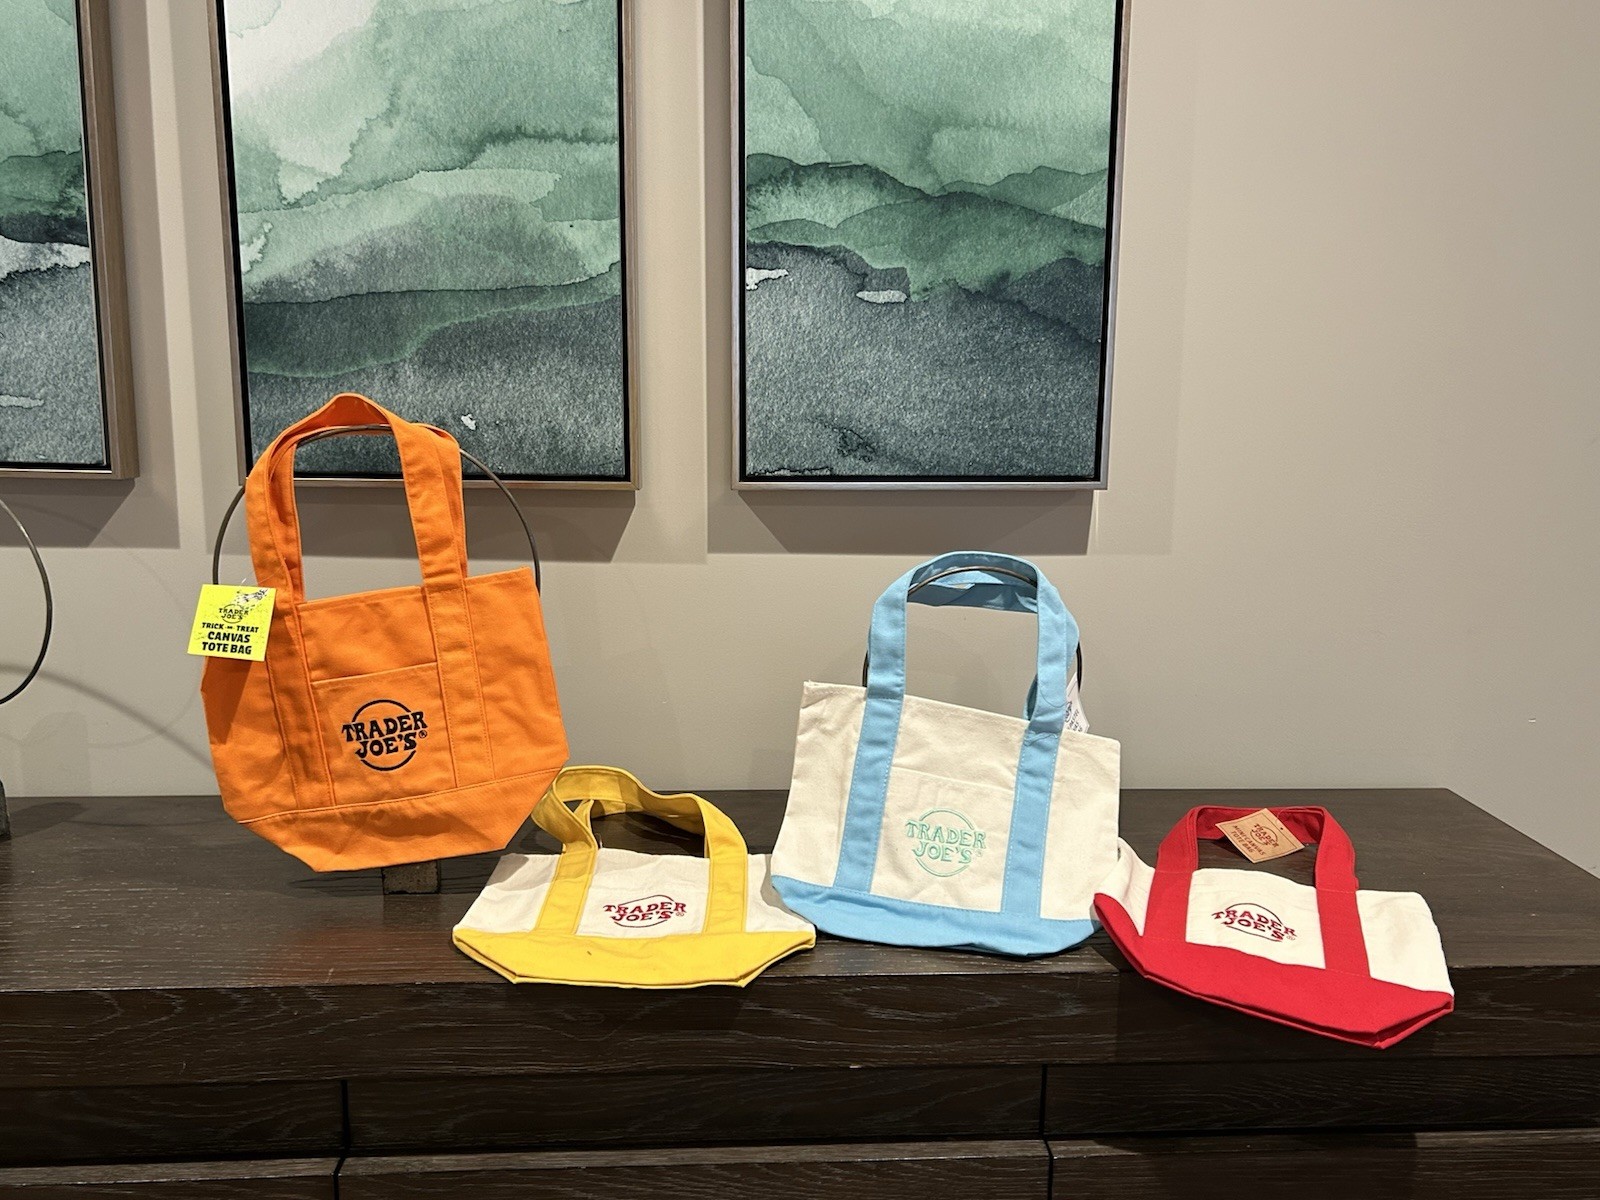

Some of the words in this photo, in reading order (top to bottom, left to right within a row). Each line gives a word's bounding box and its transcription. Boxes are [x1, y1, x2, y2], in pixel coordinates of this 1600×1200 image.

[218, 607, 249, 616] TRADER
[202, 622, 224, 630] TRICK
[236, 625, 259, 633] TREAT
[207, 631, 251, 643] CANVAS
[202, 641, 229, 653] TOTE
[230, 644, 252, 655] BAG
[341, 711, 428, 742] TRADER
[355, 732, 417, 759] JOE'S
[904, 820, 987, 849] TRADER
[1231, 830, 1244, 843] TOTE
[1242, 842, 1254, 853] BAG
[1244, 836, 1266, 856] CANVAS
[1253, 823, 1279, 848] TRADER
[911, 840, 973, 864] JOE'S
[602, 901, 687, 914] TRADER
[609, 910, 674, 922] JOE'S
[1211, 909, 1298, 937] TRADER
[1220, 917, 1285, 941] JOE'S
